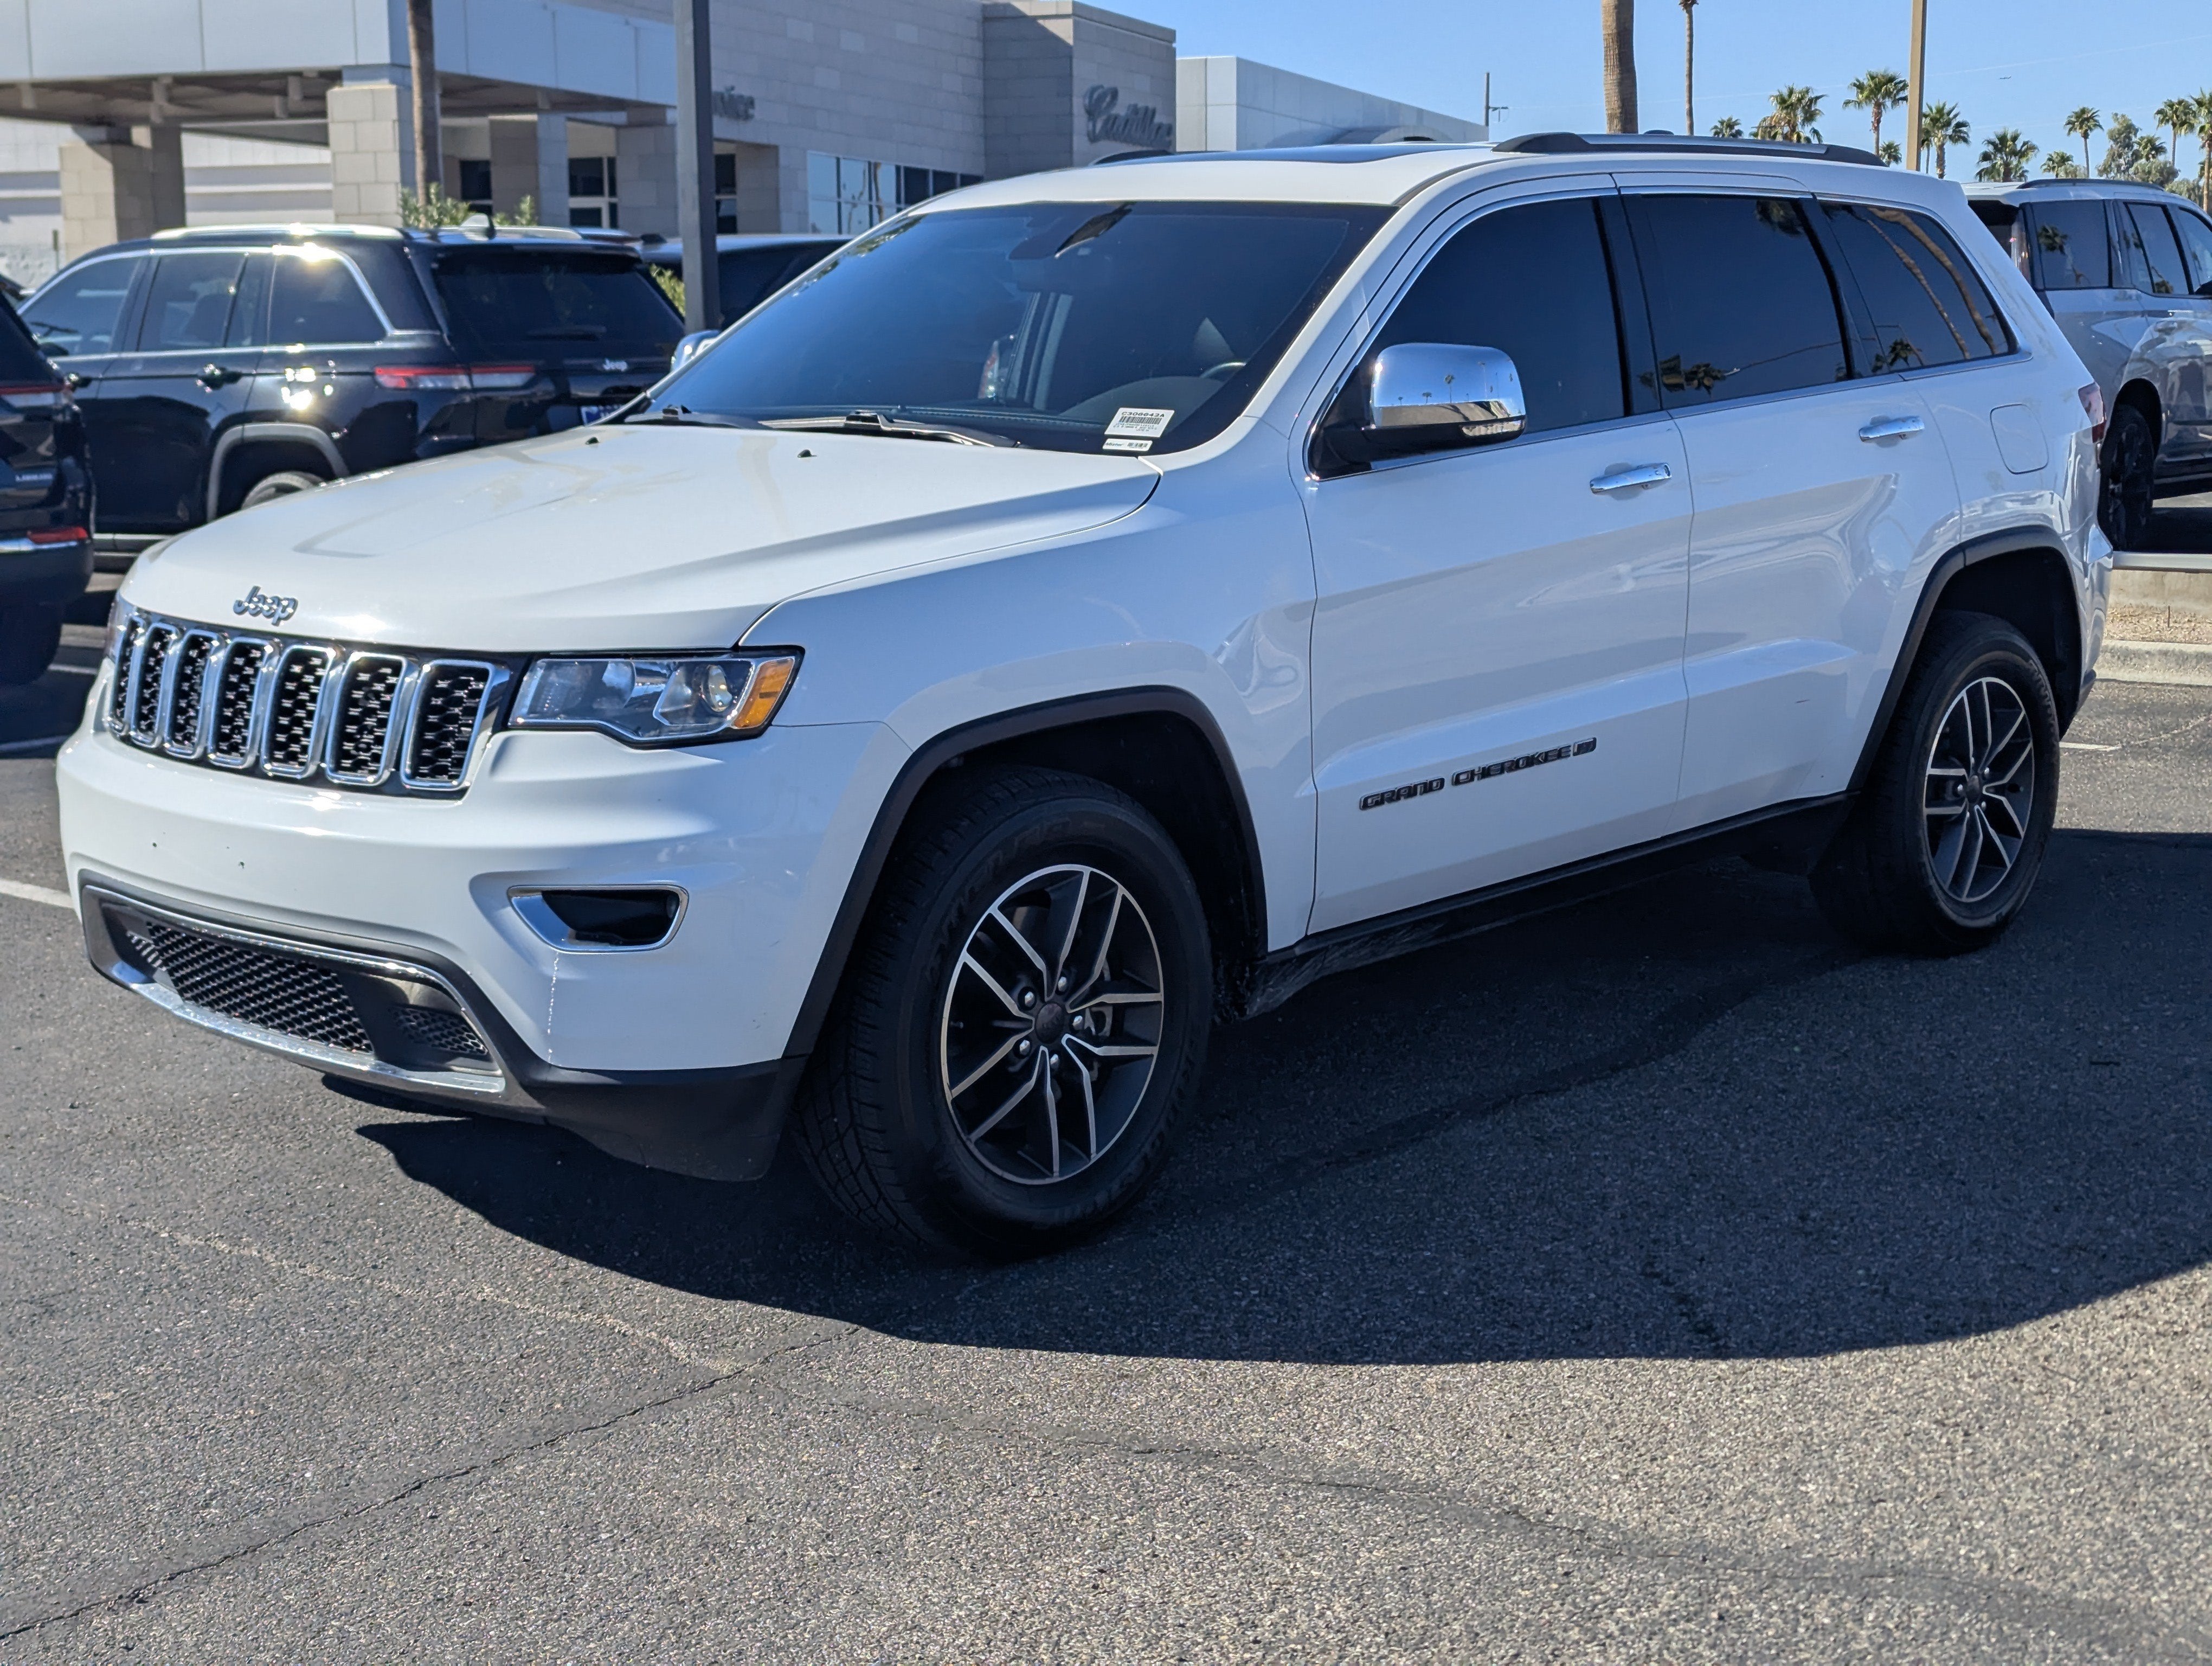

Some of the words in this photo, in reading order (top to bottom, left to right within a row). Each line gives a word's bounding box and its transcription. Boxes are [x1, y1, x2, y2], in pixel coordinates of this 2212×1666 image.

[1083, 85, 1173, 148] Cadillac
[603, 358, 628, 372] Jeep
[233, 585, 299, 627] Jeep
[1359, 776, 1445, 811] GRAND
[1452, 744, 1572, 786] CHEROKEE
